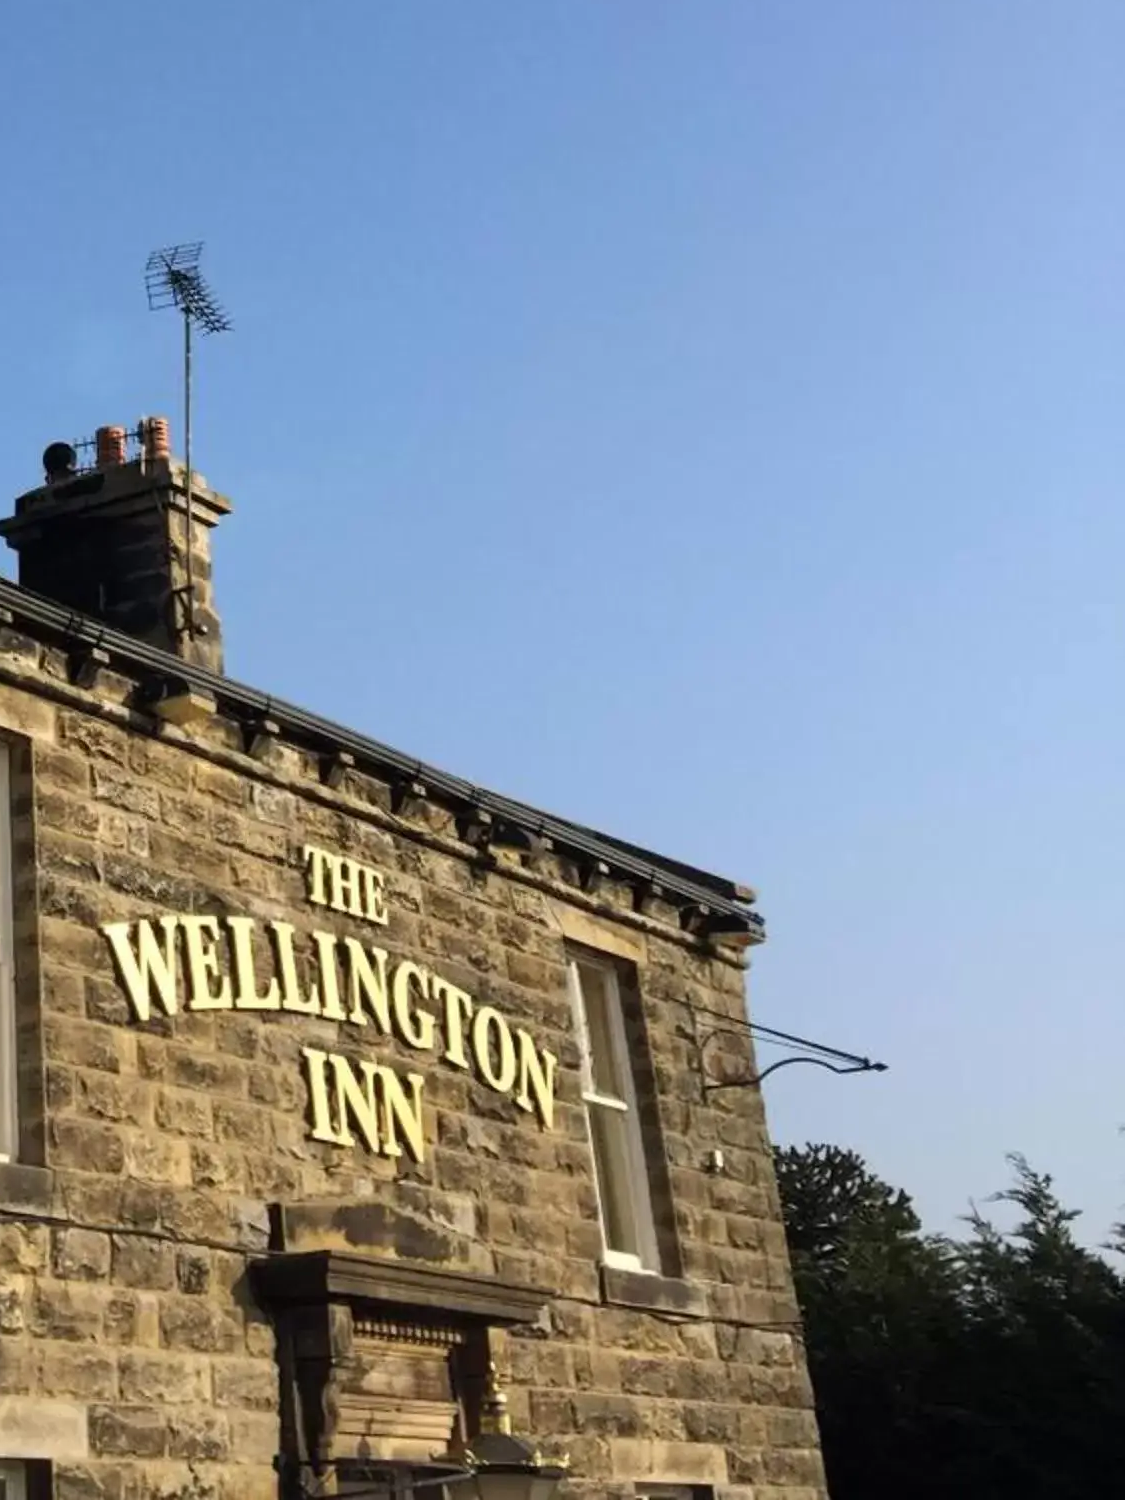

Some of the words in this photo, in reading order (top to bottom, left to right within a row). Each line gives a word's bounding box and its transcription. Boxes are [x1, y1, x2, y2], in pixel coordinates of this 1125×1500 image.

[303, 844, 389, 925] THE
[101, 915, 558, 1131] WELLINGTON
[302, 1047, 425, 1164] INN
